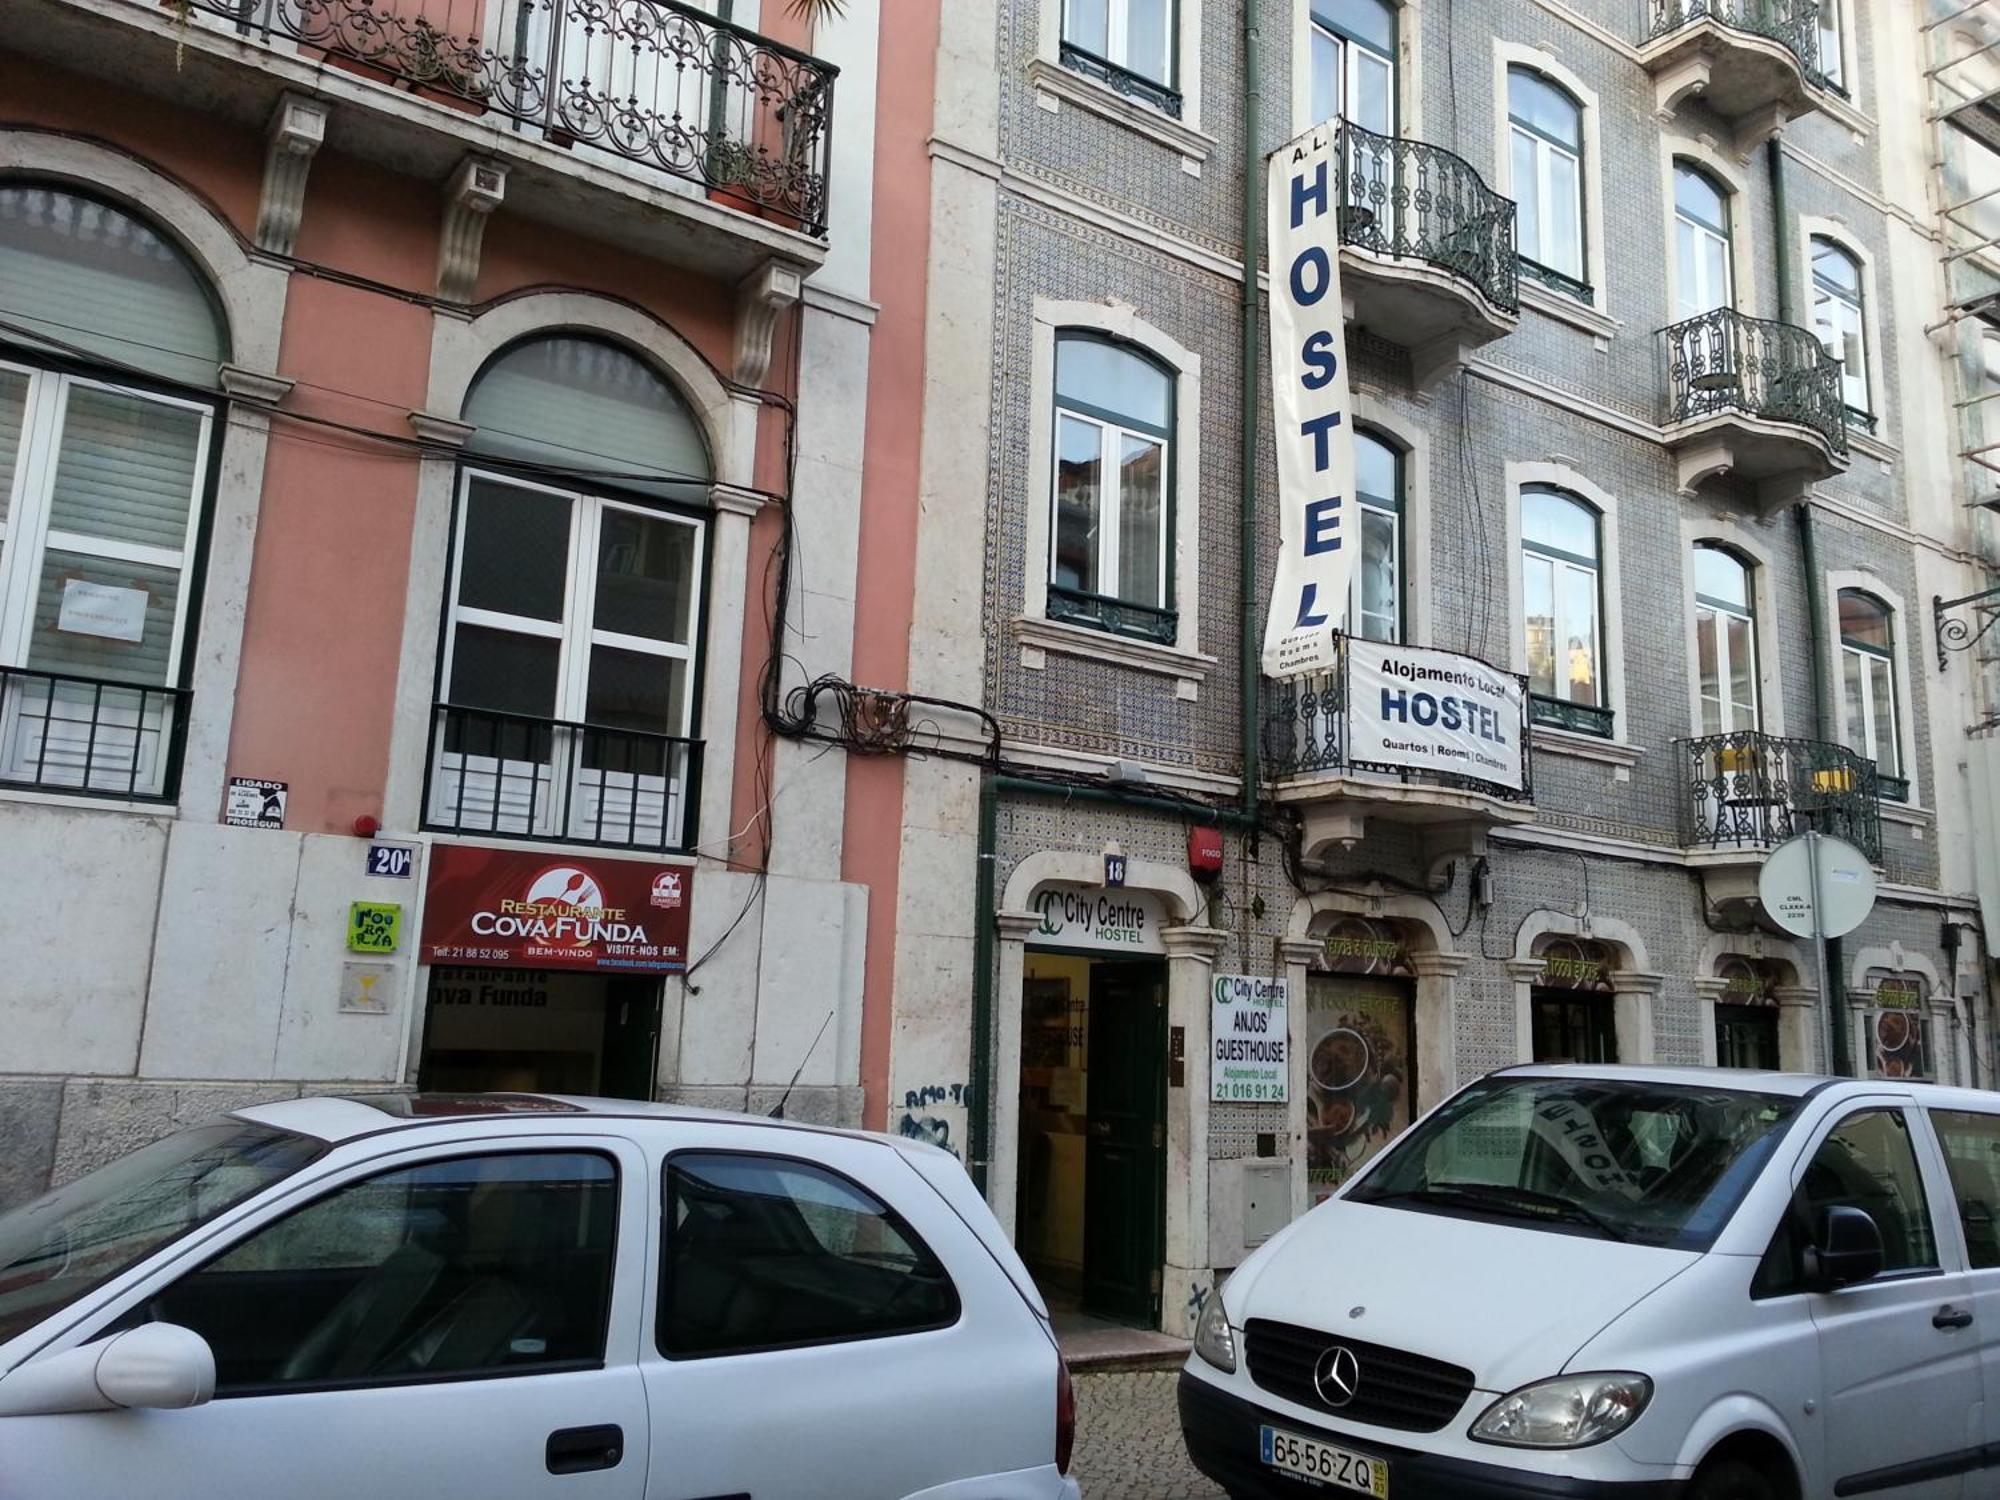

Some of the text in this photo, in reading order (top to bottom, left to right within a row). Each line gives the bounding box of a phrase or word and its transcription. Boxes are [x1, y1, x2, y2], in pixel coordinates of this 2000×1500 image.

[1292, 136, 1328, 164] A. L.
[1290, 160, 1342, 629] HOSTEL
[1280, 654, 1320, 670] Chambres
[1381, 659, 1475, 688] Alojamento
[1380, 687, 1506, 745] HOSTEL
[1382, 738, 1508, 771] Quartos Rooms Chambres
[236, 779, 283, 790] LIGADO
[227, 816, 281, 829] PROSEGUR
[1108, 861, 1123, 881] 18
[501, 899, 626, 921] RESTAURANTE
[1064, 893, 1093, 932] City
[1097, 896, 1145, 930] Centre
[471, 911, 648, 944] COVA FUNDA
[1095, 927, 1144, 944] HOSTEL
[452, 947, 464, 957] 21
[527, 947, 593, 958] BEM-VINDO
[606, 943, 680, 957] VISITE-NOS EM:
[478, 985, 547, 1007] Funda
[1234, 978, 1252, 1001] City
[1255, 979, 1285, 1000] Centre
[1233, 1011, 1268, 1034] ANJOS
[1216, 1038, 1285, 1063] GUESTHOUSE
[1223, 1066, 1278, 1082] Alojamento Local
[1216, 1083, 1284, 1099] 21 016 91 24
